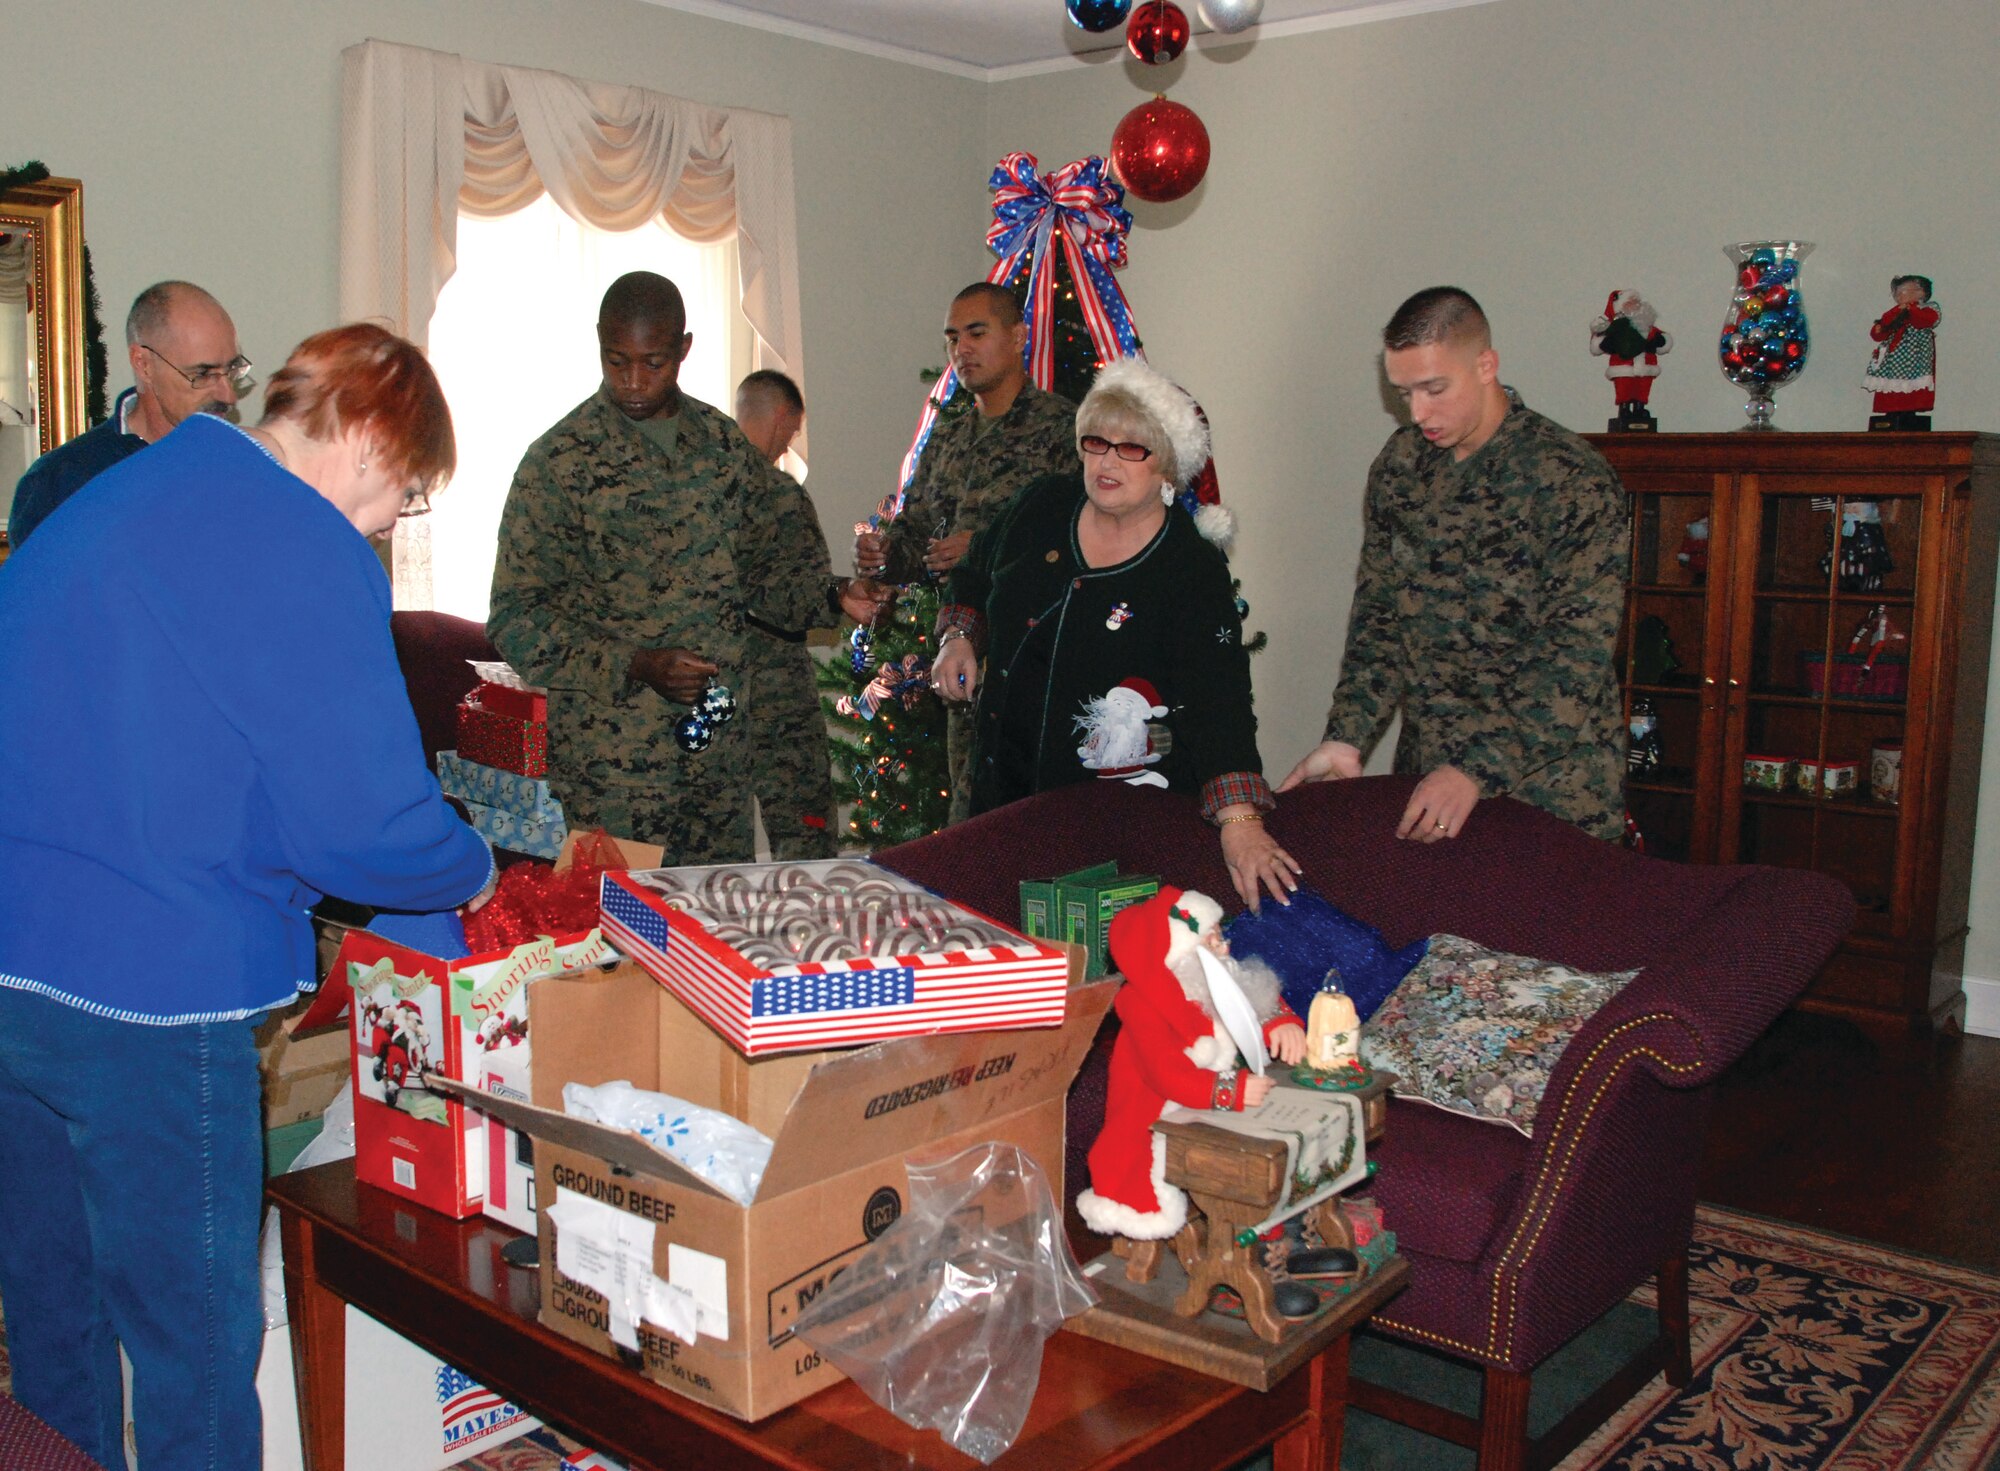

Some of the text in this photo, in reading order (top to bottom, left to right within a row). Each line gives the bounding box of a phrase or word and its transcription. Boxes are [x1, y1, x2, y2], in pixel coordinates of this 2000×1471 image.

[471, 938, 606, 1022] Snoring Sant
[975, 1052, 1017, 1082] KEEP
[864, 1064, 976, 1120] REFRIGERATED
[552, 1163, 676, 1224] GROUND BEEF
[566, 1297, 680, 1360] GROU BEEF
[795, 1350, 821, 1377] LOS
[443, 1403, 524, 1444] MAYES
[444, 1430, 487, 1452] WHOLESALE
